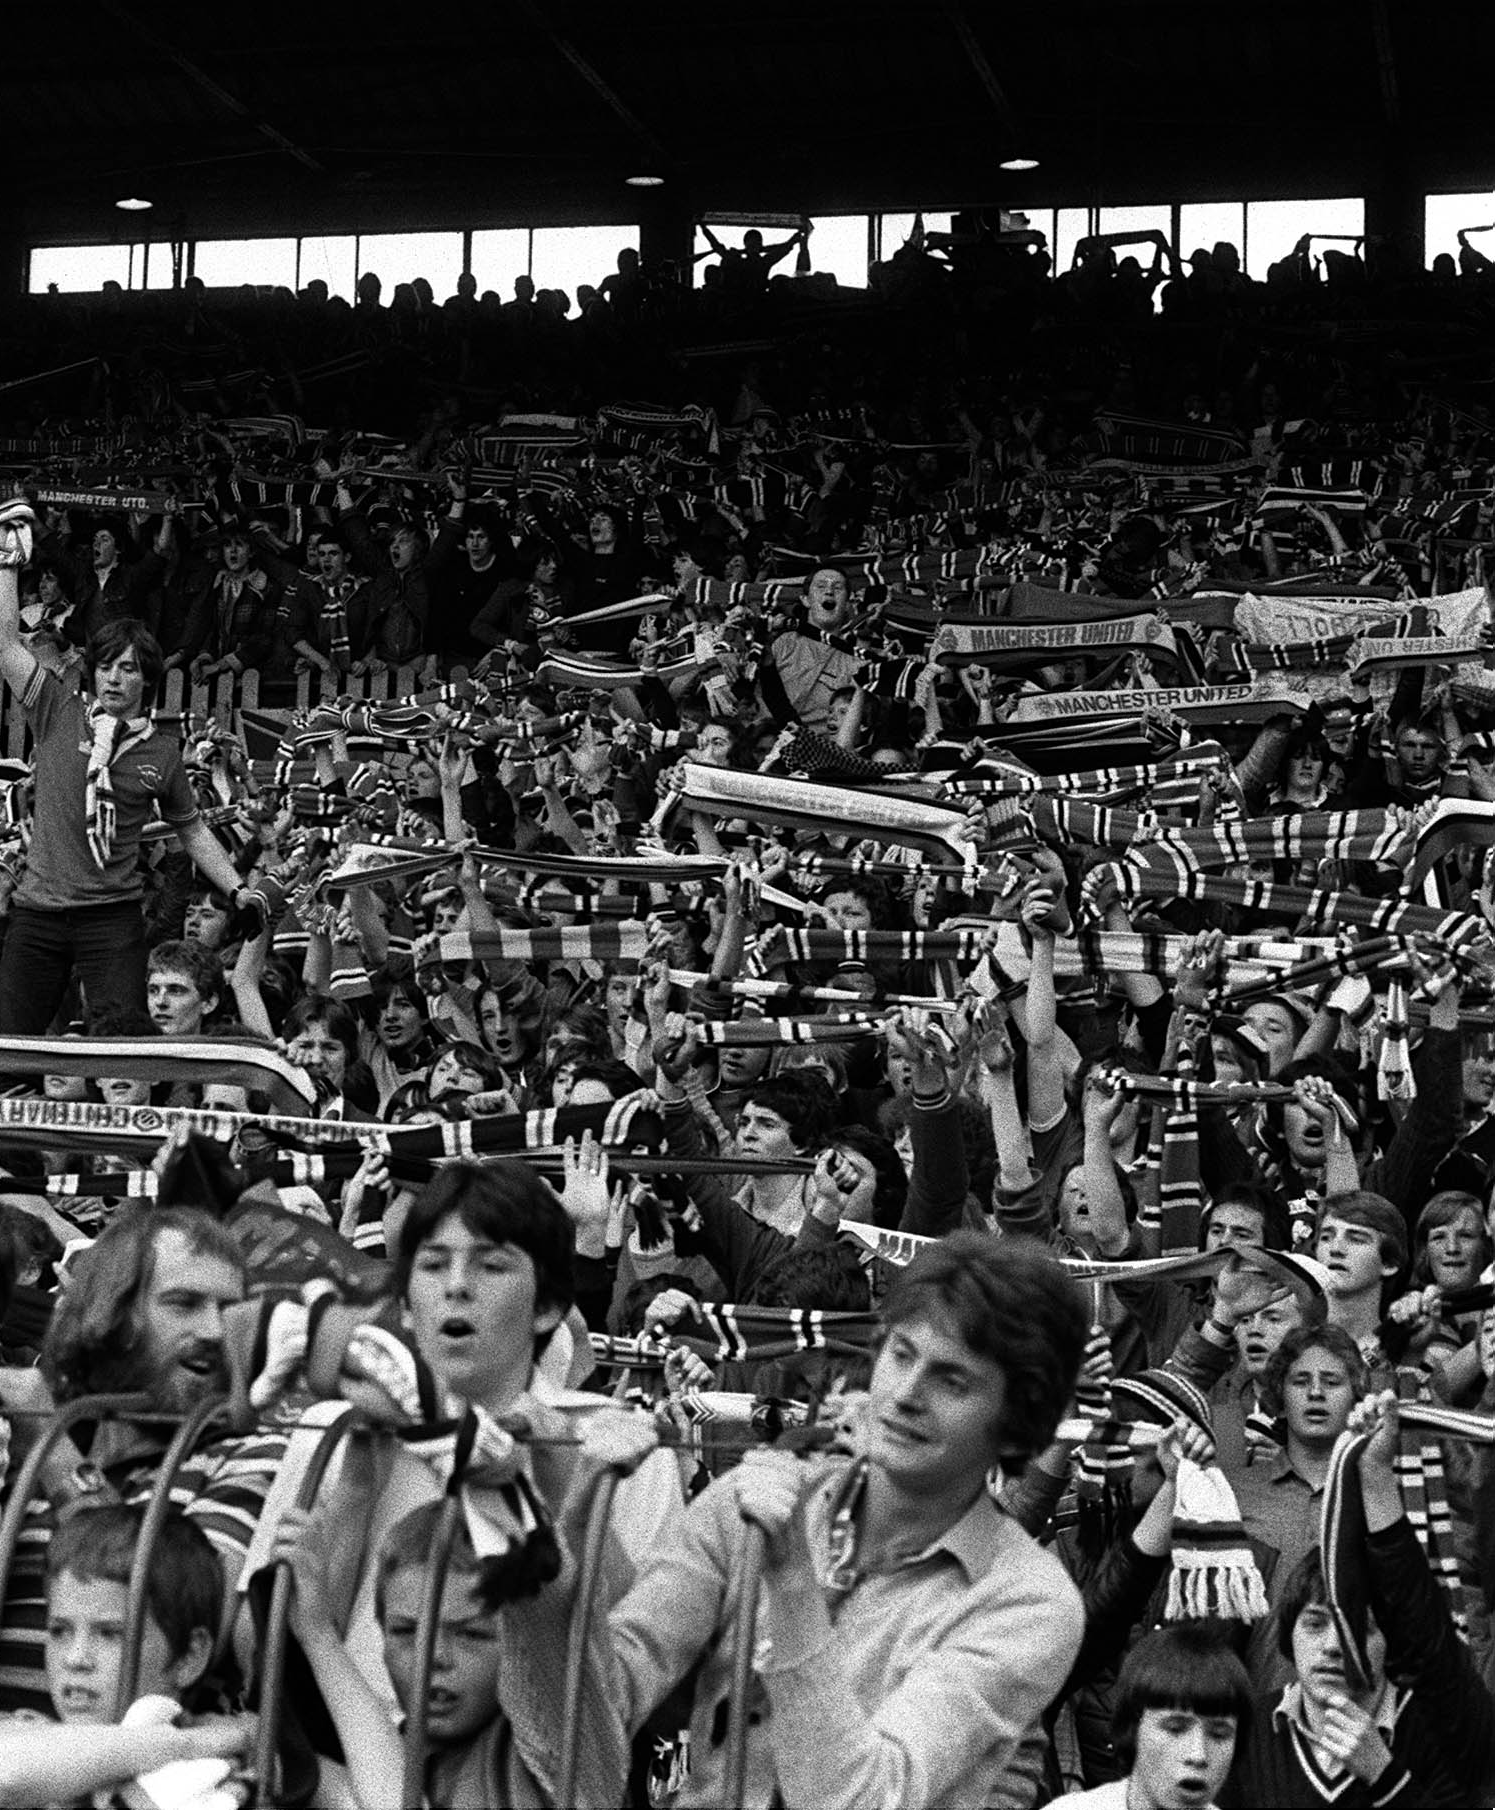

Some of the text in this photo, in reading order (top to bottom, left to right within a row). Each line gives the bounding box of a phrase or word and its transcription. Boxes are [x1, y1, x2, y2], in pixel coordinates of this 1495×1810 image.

[37, 489, 117, 507] MANCHESTER
[971, 620, 1135, 652] MANCHESTER UNITED
[1055, 685, 1253, 714] MANCHESTER UNITED
